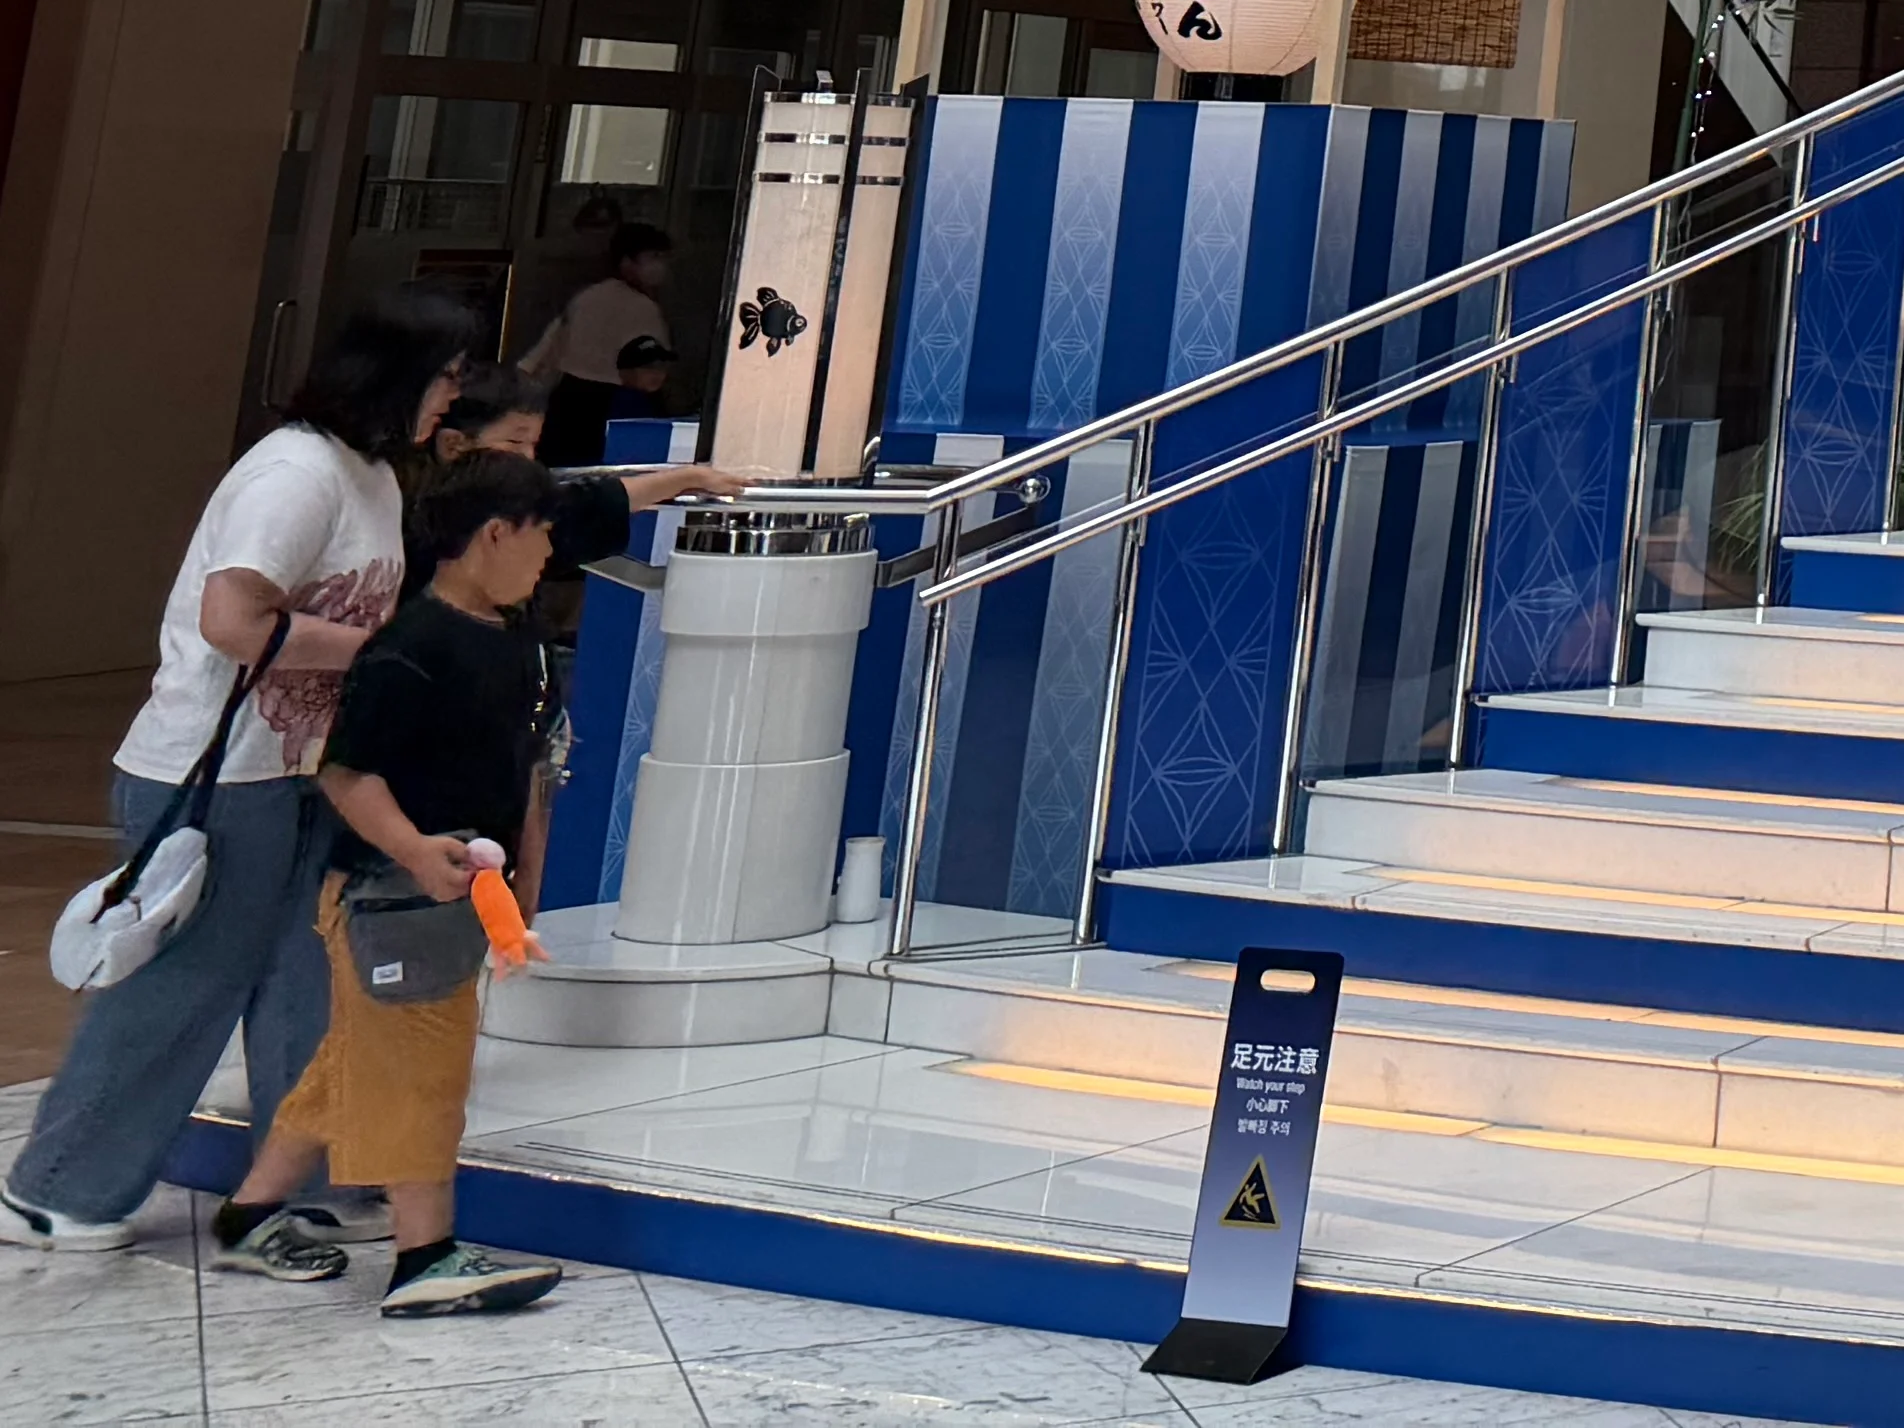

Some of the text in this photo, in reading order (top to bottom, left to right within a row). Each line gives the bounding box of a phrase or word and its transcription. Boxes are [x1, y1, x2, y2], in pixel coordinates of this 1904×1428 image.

[1231, 1043, 1319, 1074] 足元注意
[1265, 1082, 1285, 1093] your
